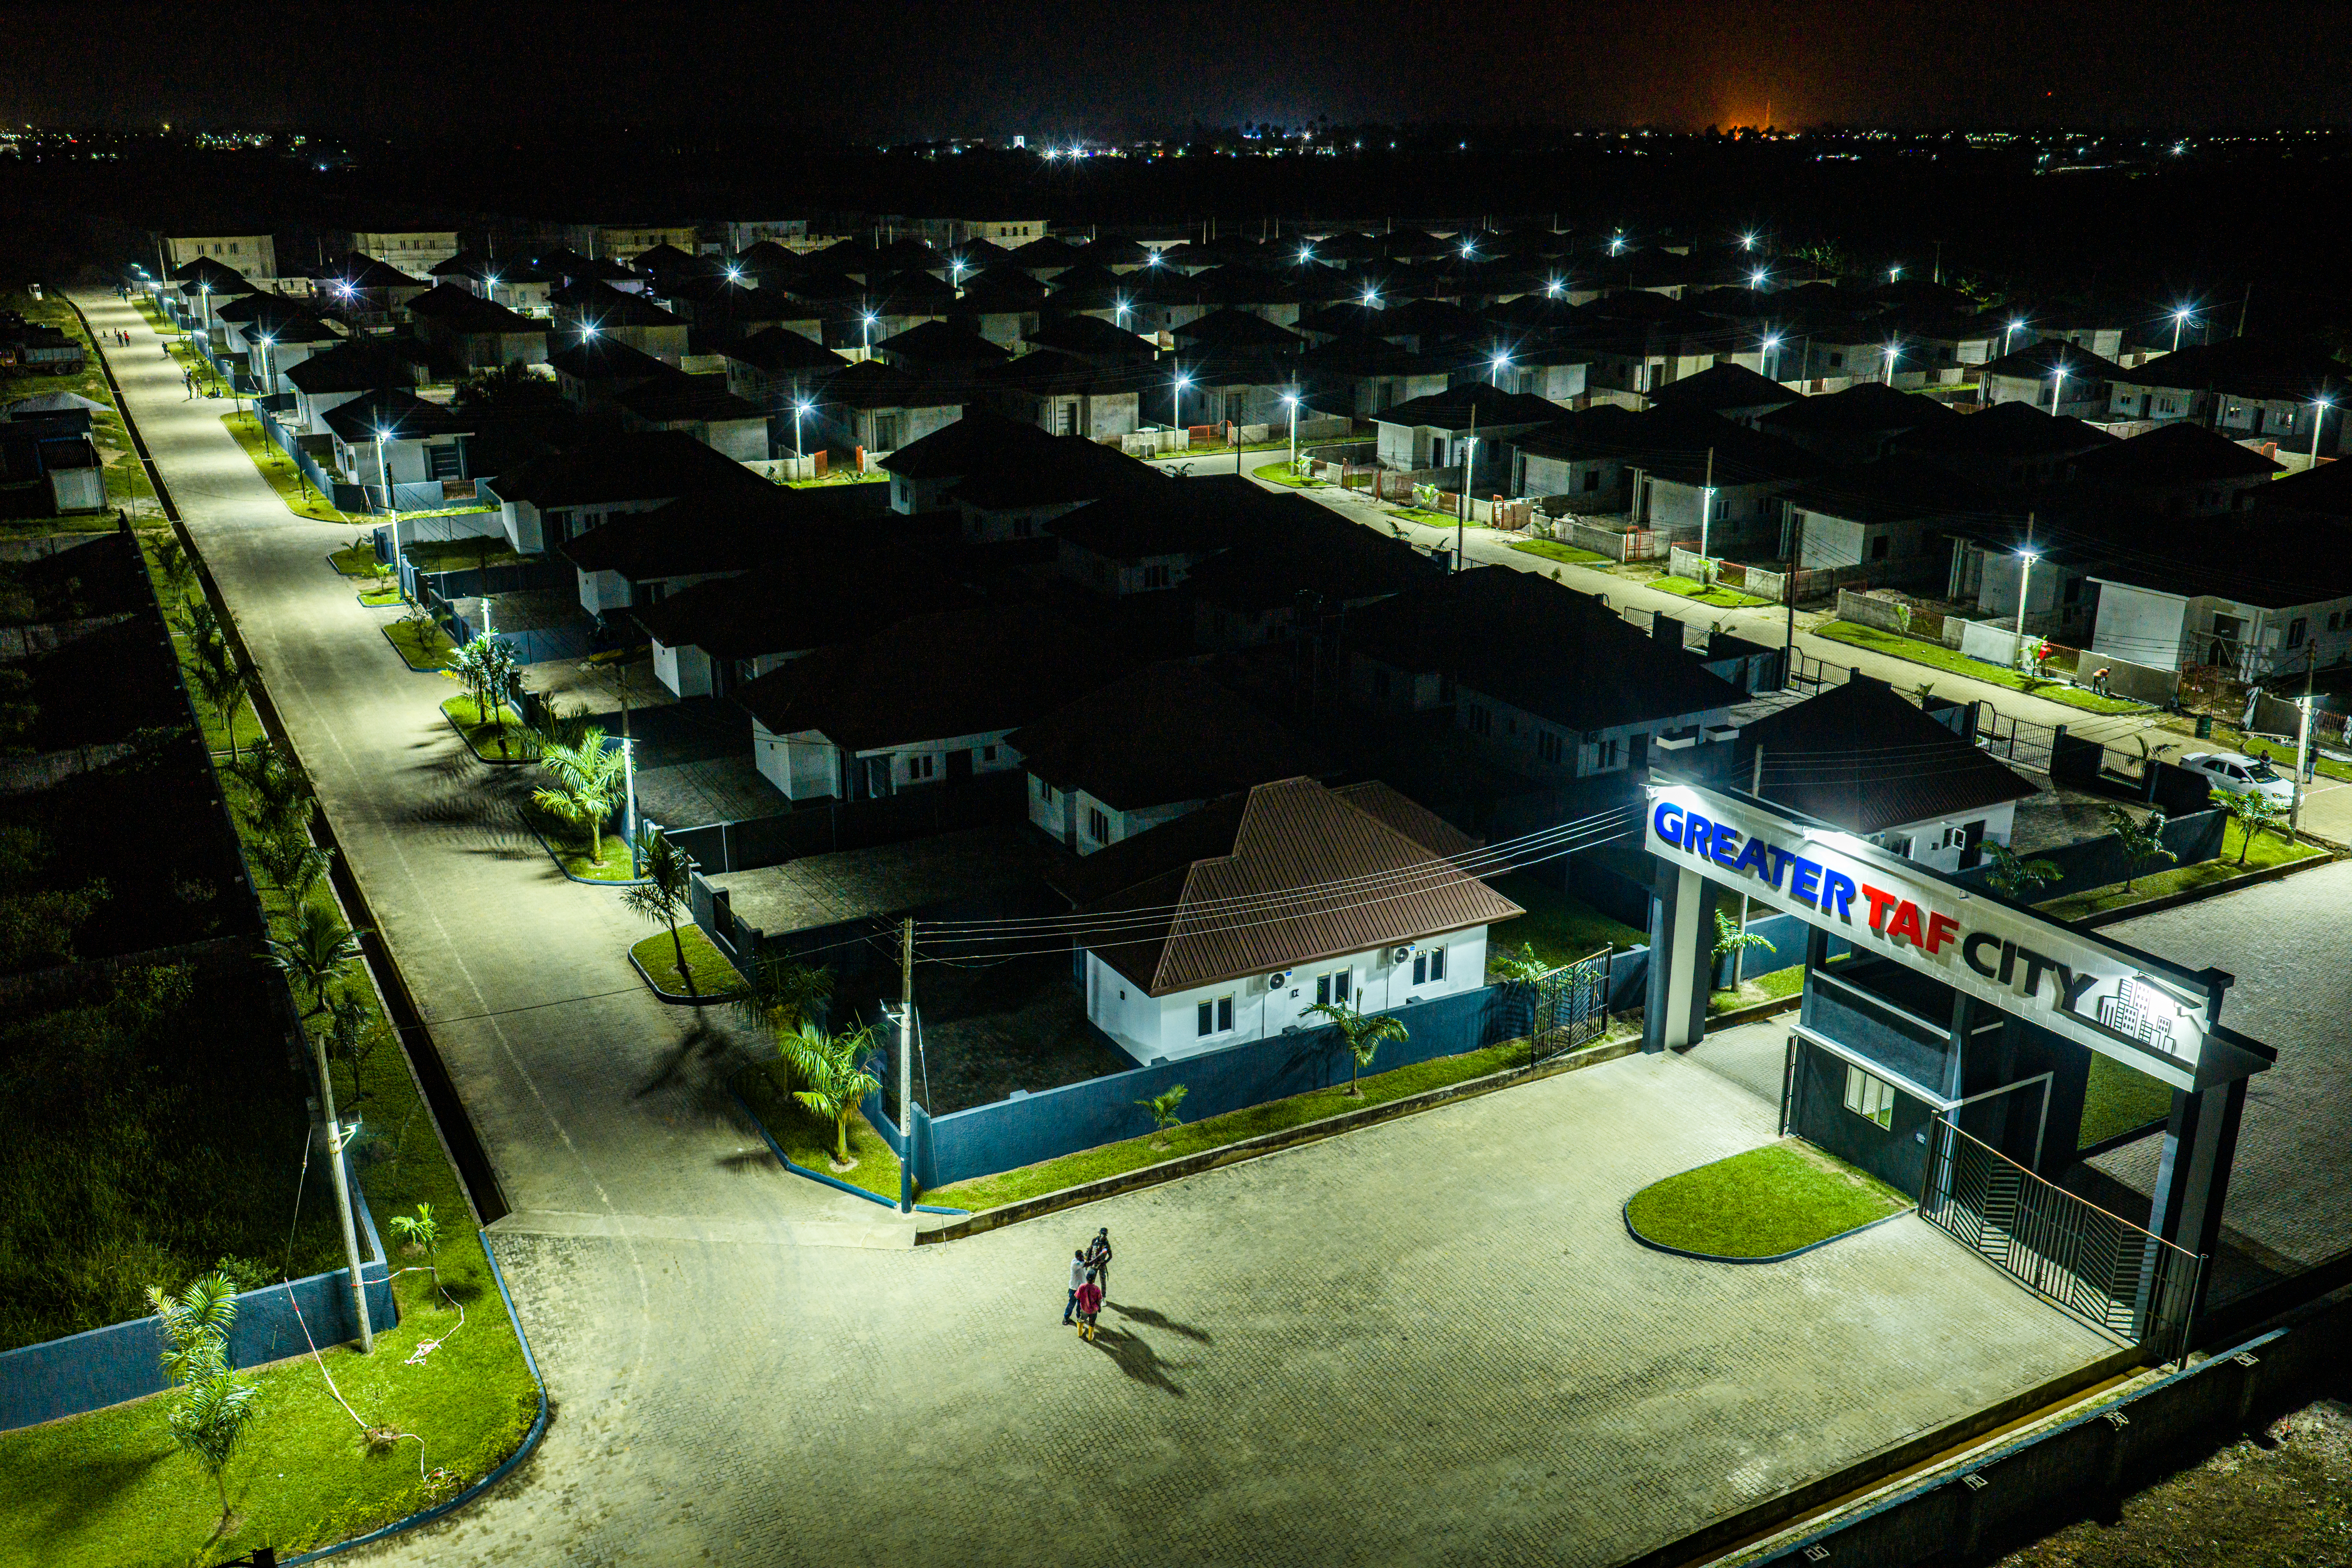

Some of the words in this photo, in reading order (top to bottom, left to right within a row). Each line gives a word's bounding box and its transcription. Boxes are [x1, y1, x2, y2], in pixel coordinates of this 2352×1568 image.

[1654, 802, 1855, 917] GREATER
[1862, 883, 1959, 954] TAF
[1963, 932, 2099, 1012] CITY
